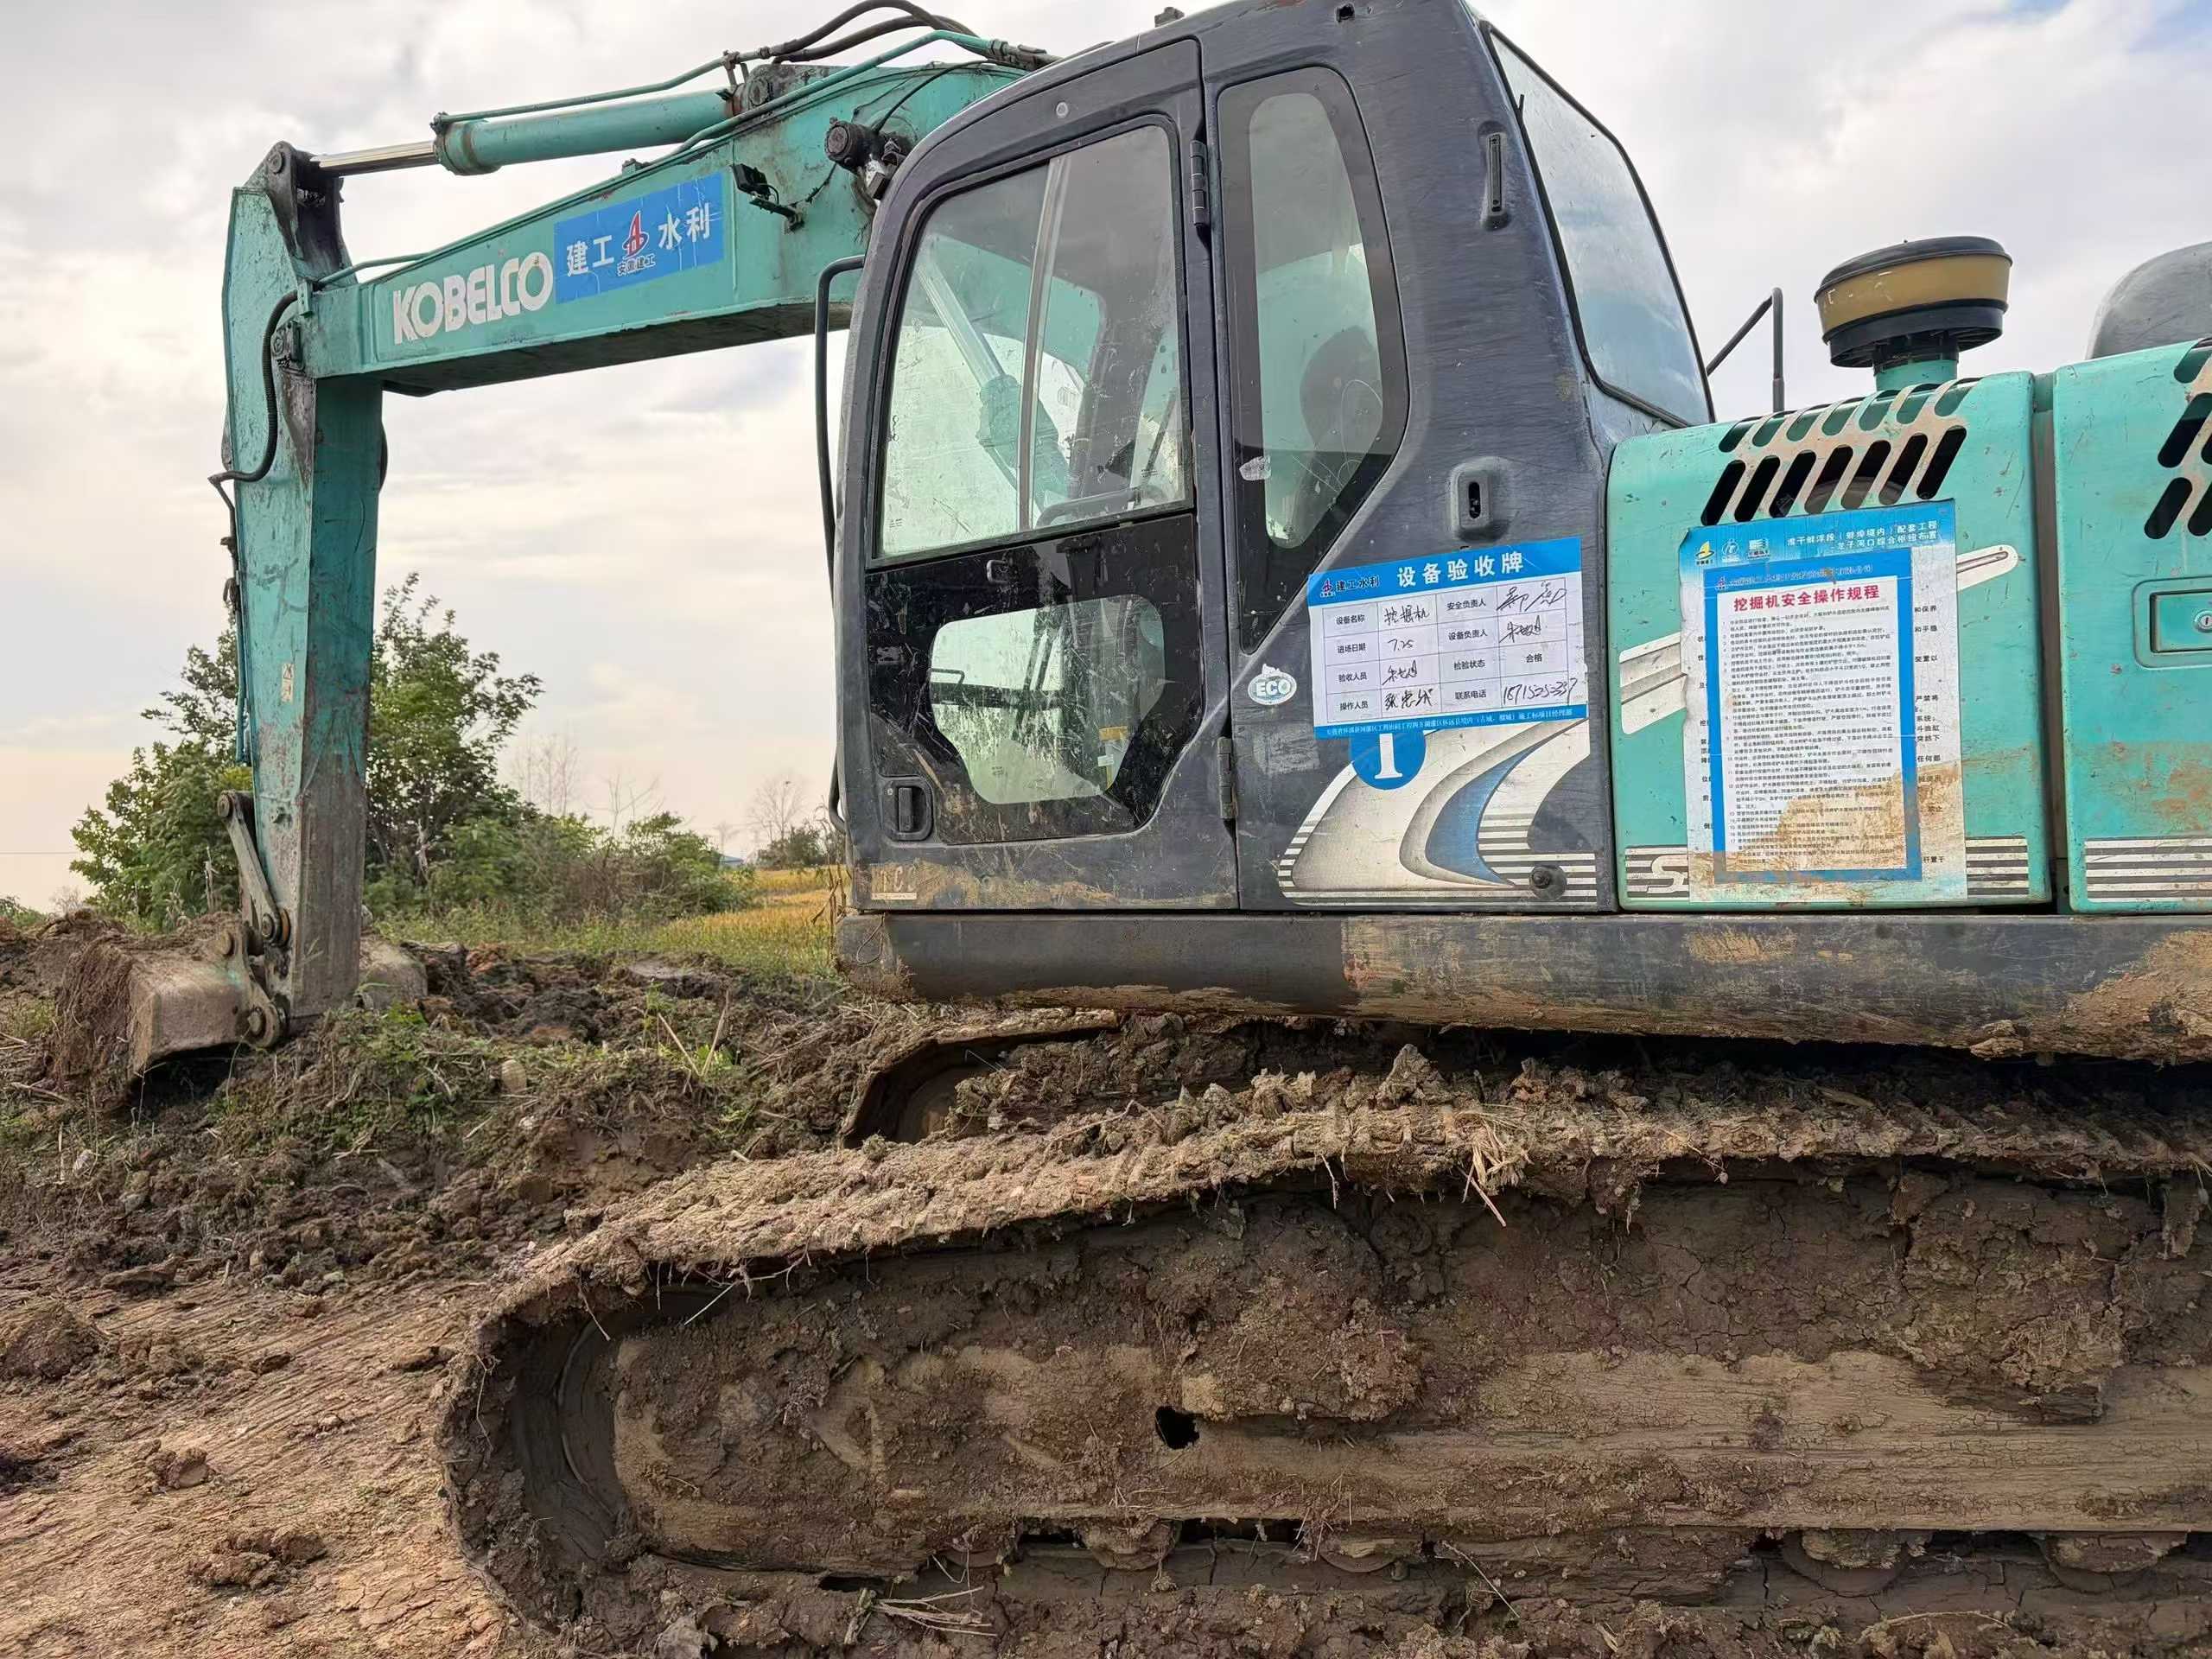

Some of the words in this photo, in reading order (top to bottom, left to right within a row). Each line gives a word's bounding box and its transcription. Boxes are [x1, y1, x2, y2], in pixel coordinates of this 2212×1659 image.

[566, 234, 615, 277] 建工
[658, 202, 710, 251] 水利
[393, 251, 554, 346] KOBELCO
[1396, 551, 1524, 588] 设备验收牌
[1336, 575, 1380, 593] 建工水利
[1447, 598, 1486, 611] 安全负责人
[1733, 584, 1880, 613] 挖掘机安全操作规程
[1336, 613, 1365, 625] 设备名称
[1448, 628, 1488, 641] 设备负责人
[1338, 642, 1366, 654] 进场日期
[1453, 659, 1485, 671] 检验状态
[1526, 653, 1542, 664] 合格
[1338, 671, 1367, 683] 验收人员
[1255, 679, 1291, 696] ECO
[1455, 689, 1487, 701] 联系电话
[1340, 700, 1369, 711] 操作人员
